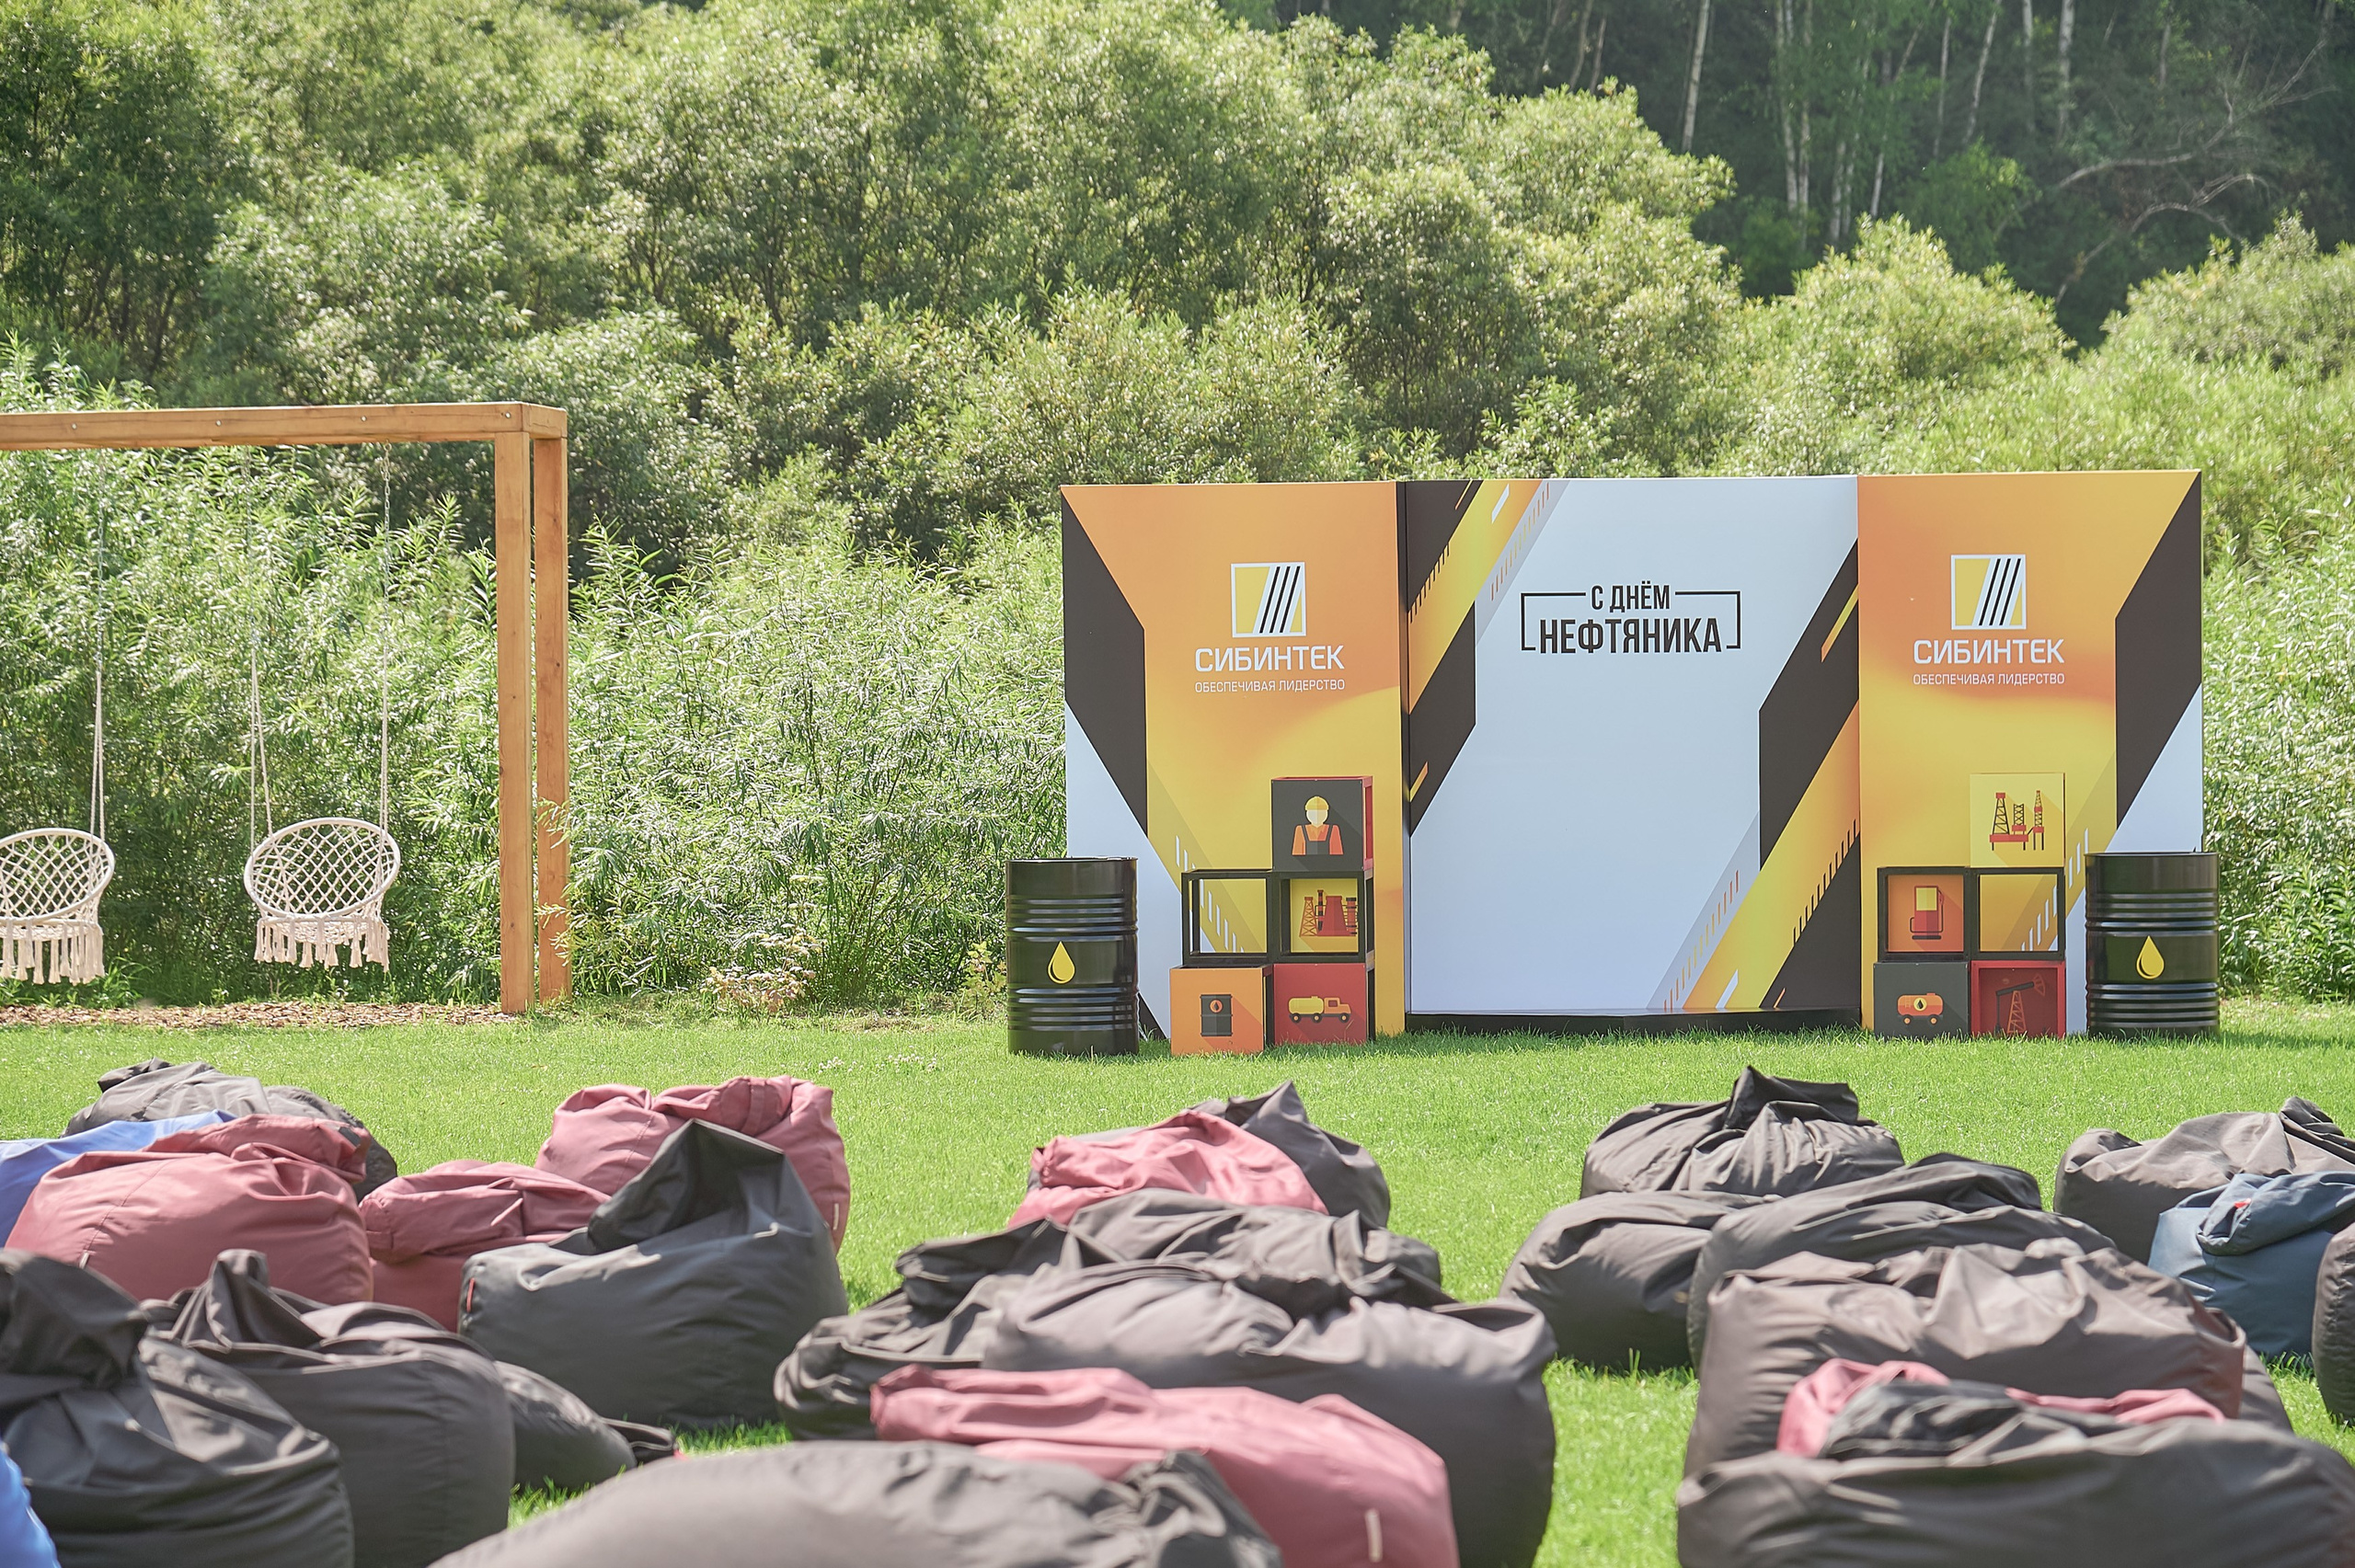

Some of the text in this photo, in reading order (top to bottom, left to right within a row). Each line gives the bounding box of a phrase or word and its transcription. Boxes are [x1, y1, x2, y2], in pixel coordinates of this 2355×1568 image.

[1591, 580, 1671, 613] С ДНЁМ
[1539, 617, 1722, 654] НЕФТЯНИКА
[1195, 645, 1345, 672] СИБИНТЕК
[1913, 638, 2065, 664] СИБИНТЕК
[1194, 679, 1345, 692] ОБЕСПЕЧИВАЯ ЛИДЕРСТВО
[1913, 672, 2065, 686] ОБЕСПЕЧИВАЯ ЛИДЕРСТВО
